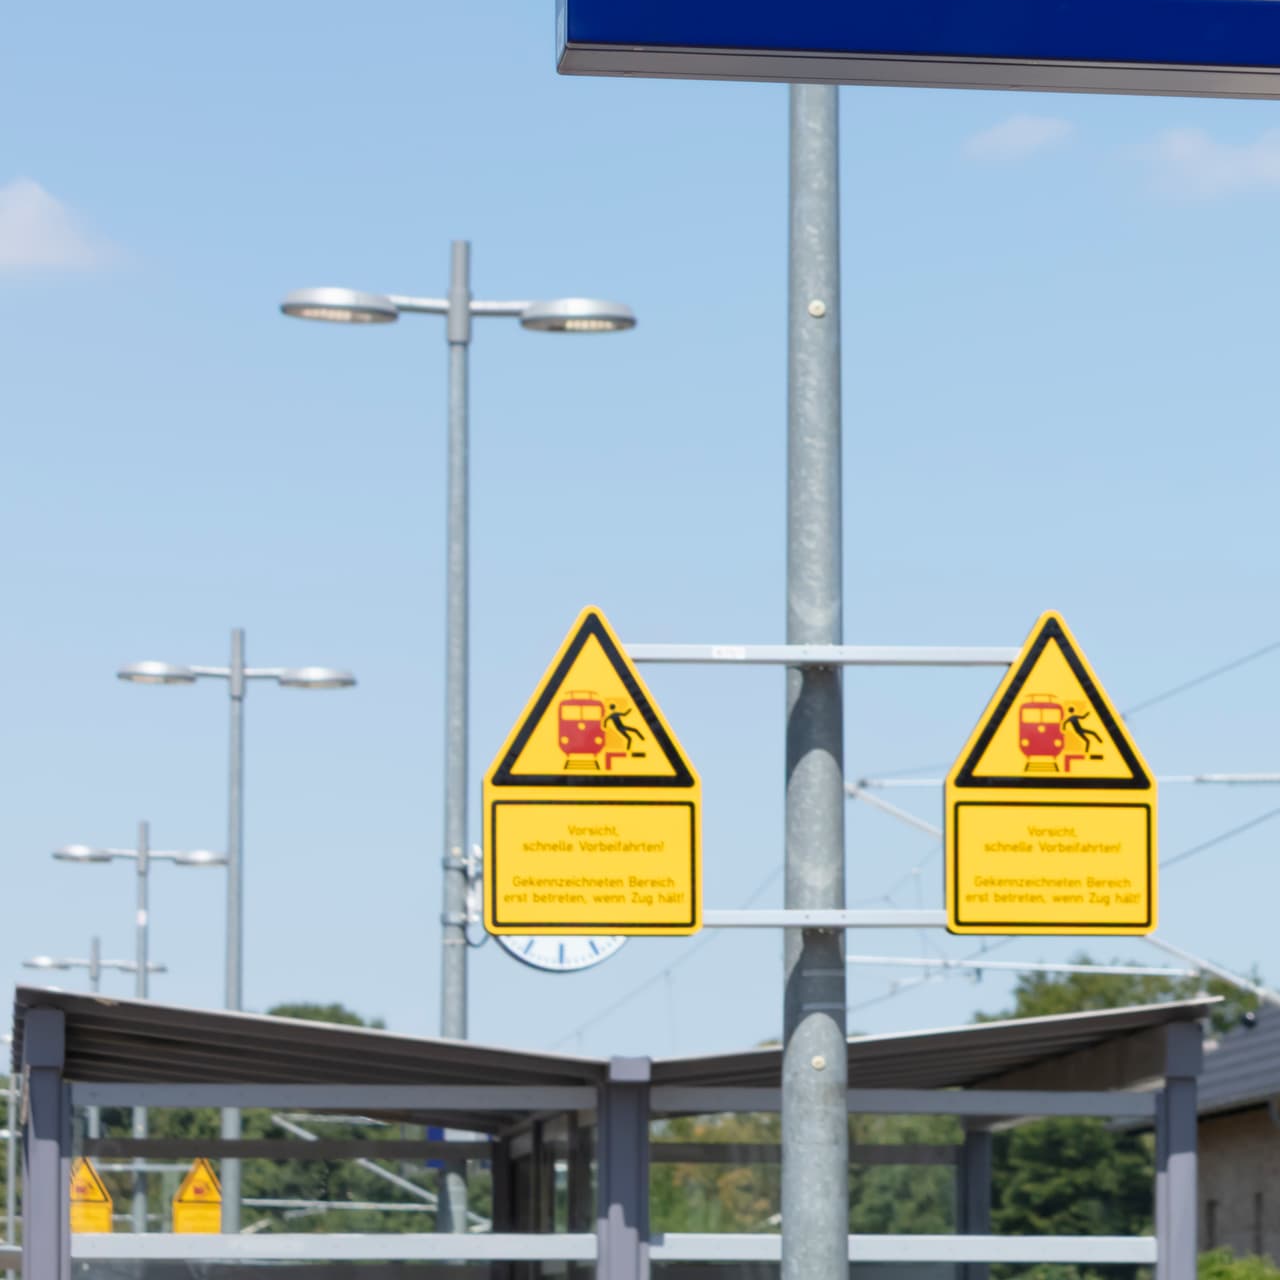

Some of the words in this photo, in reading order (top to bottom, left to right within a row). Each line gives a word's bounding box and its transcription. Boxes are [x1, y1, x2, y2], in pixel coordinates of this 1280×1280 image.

[523, 841, 573, 852] schnelle
[579, 841, 664, 852] Vorbeifahrten!
[513, 876, 623, 888] Gekennzeichneten
[629, 876, 675, 888] Bereich
[504, 893, 528, 903] erst
[593, 894, 625, 904] wenn
[631, 892, 653, 906] Zug
